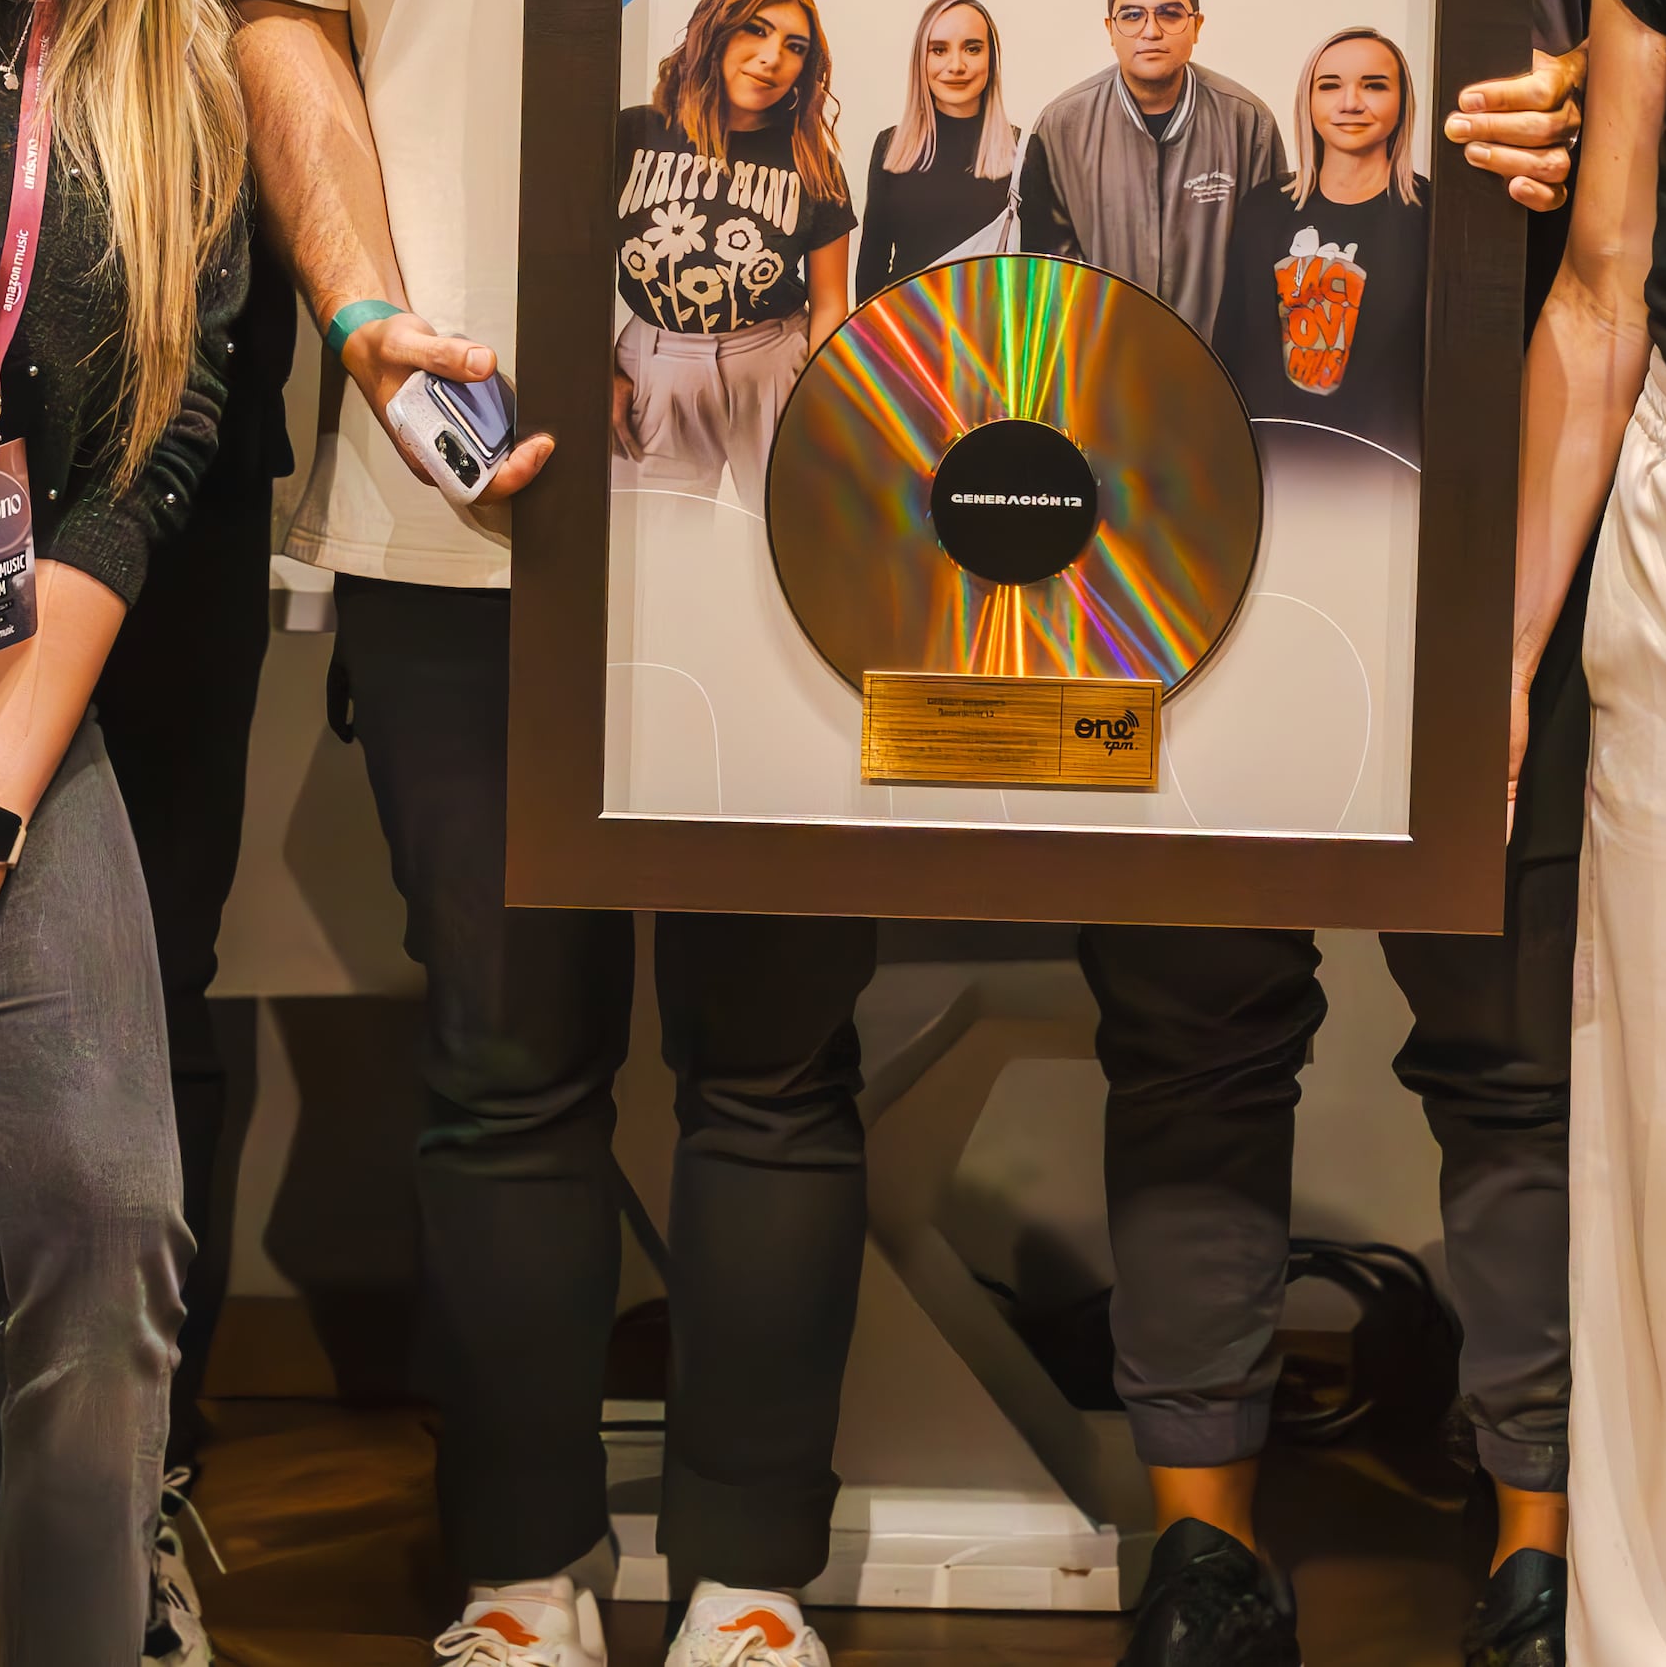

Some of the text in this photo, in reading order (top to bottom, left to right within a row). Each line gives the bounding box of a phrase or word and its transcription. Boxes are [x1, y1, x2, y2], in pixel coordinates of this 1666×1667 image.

[617, 148, 801, 237] HAPPY MIND
[3, 228, 29, 312] amazon music
[950, 493, 1083, 508] GENERACIÓN 12
[1074, 717, 1135, 740] one
